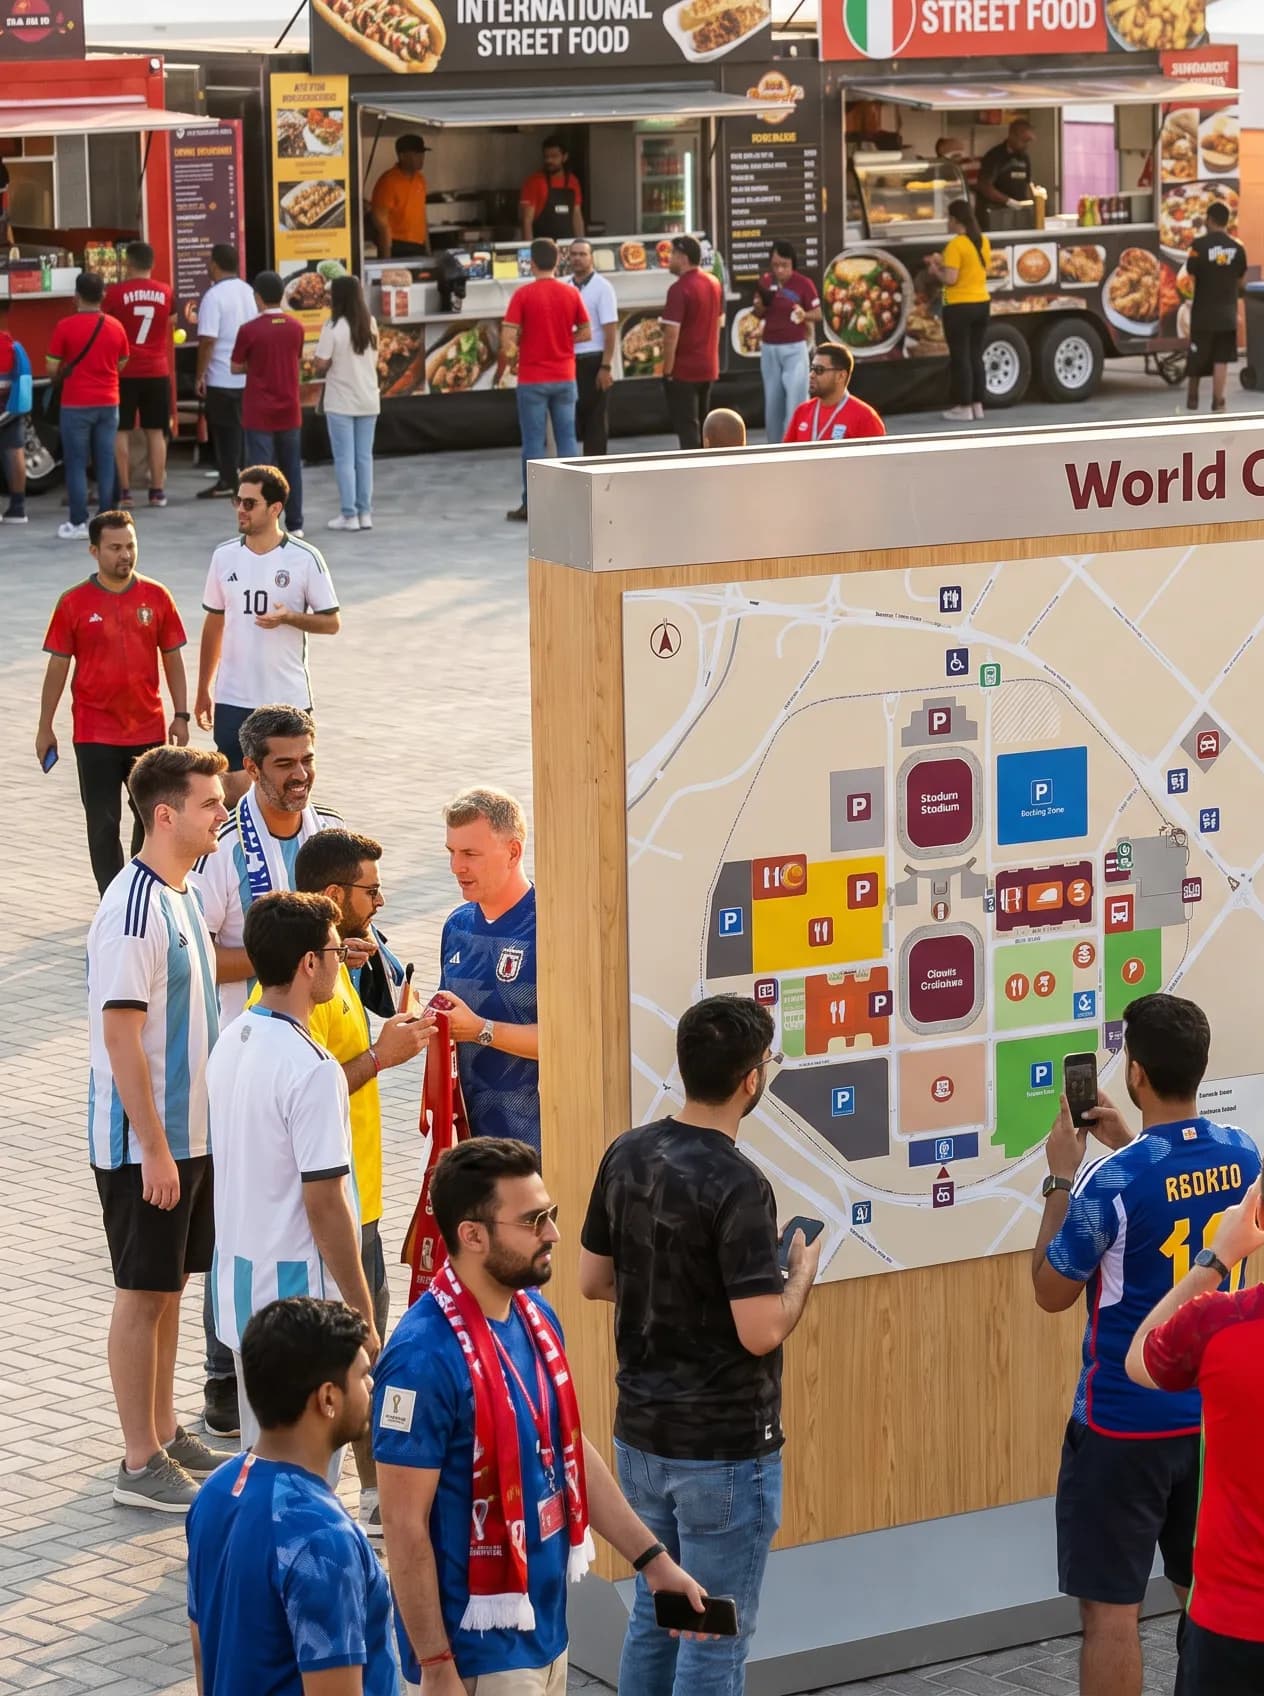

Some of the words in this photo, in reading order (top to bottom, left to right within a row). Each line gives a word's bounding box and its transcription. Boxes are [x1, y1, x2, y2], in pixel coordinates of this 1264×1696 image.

[457, 0, 653, 23] INTERNATIONAL
[922, 0, 1020, 34] STREET
[1027, 0, 1096, 30] FOOD
[477, 27, 562, 56] STREET
[568, 26, 629, 54] FOOD
[133, 305, 156, 345] 7
[1065, 449, 1226, 510] World
[243, 589, 268, 616] 10
[933, 712, 947, 730] P
[1035, 783, 1048, 800] P
[852, 797, 867, 816] P
[855, 880, 871, 902] P
[724, 912, 738, 930] P
[874, 995, 887, 1013] P
[1036, 1066, 1048, 1083] P
[837, 1091, 850, 1109] P
